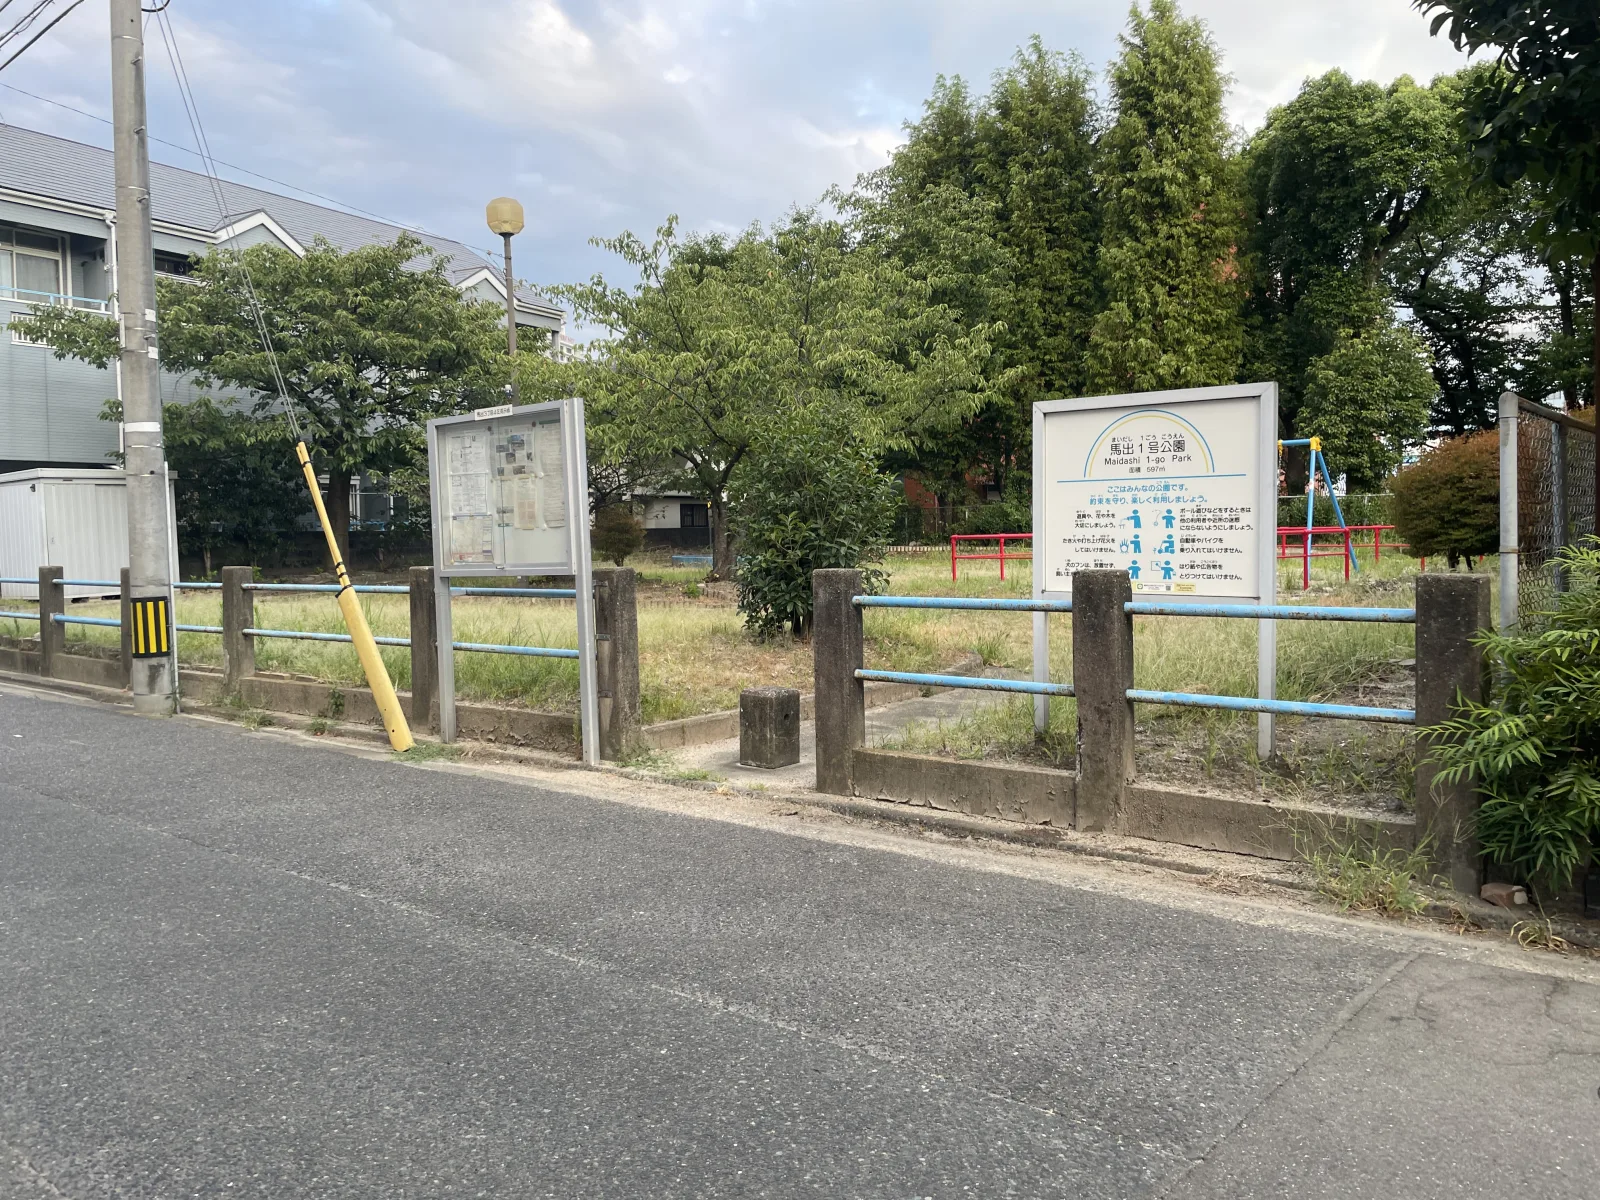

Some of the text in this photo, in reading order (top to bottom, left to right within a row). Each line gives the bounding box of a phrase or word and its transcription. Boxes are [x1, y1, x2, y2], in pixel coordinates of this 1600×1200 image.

[1104, 454, 1192, 466] Maidashi 1-go Park
